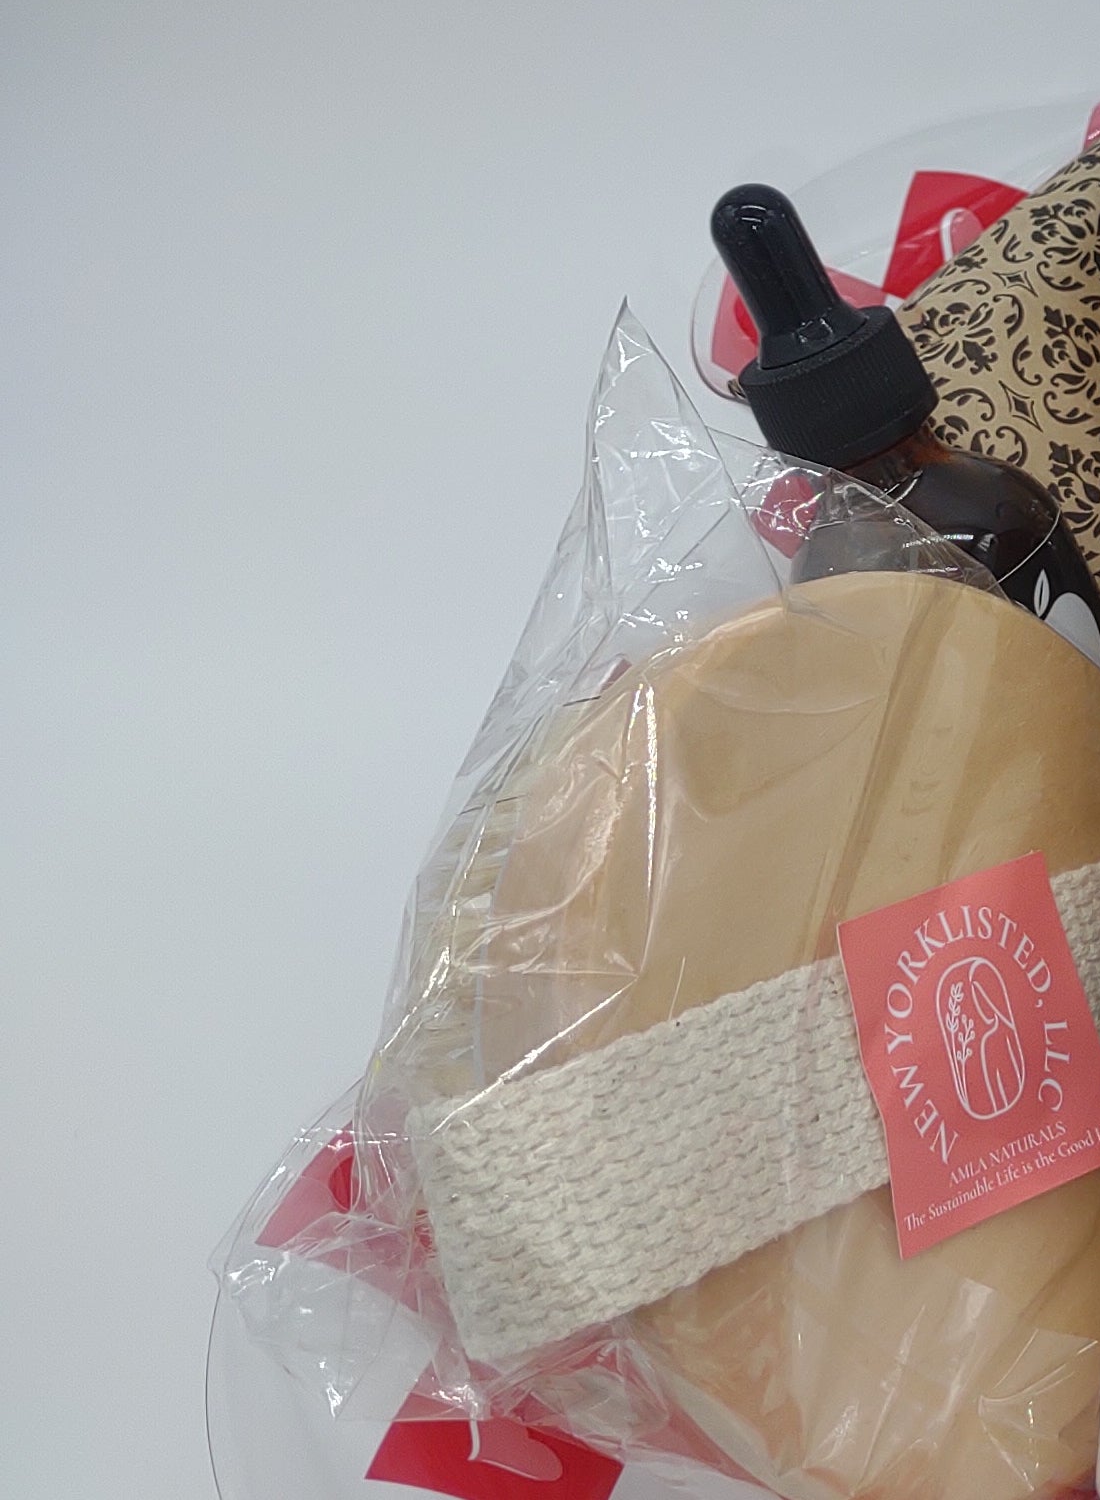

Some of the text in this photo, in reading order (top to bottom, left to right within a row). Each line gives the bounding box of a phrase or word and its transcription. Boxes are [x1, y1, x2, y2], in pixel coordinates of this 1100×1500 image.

[1038, 1020, 1070, 1112] LLC
[904, 1212, 926, 1232] The
[928, 1177, 995, 1220] Sustainable
[997, 1162, 1021, 1187] Life
[1022, 1161, 1033, 1175] is
[1035, 1149, 1056, 1169] the
[1057, 1131, 1095, 1158] Good
[949, 1120, 1067, 1188] AMLA NATURALS
